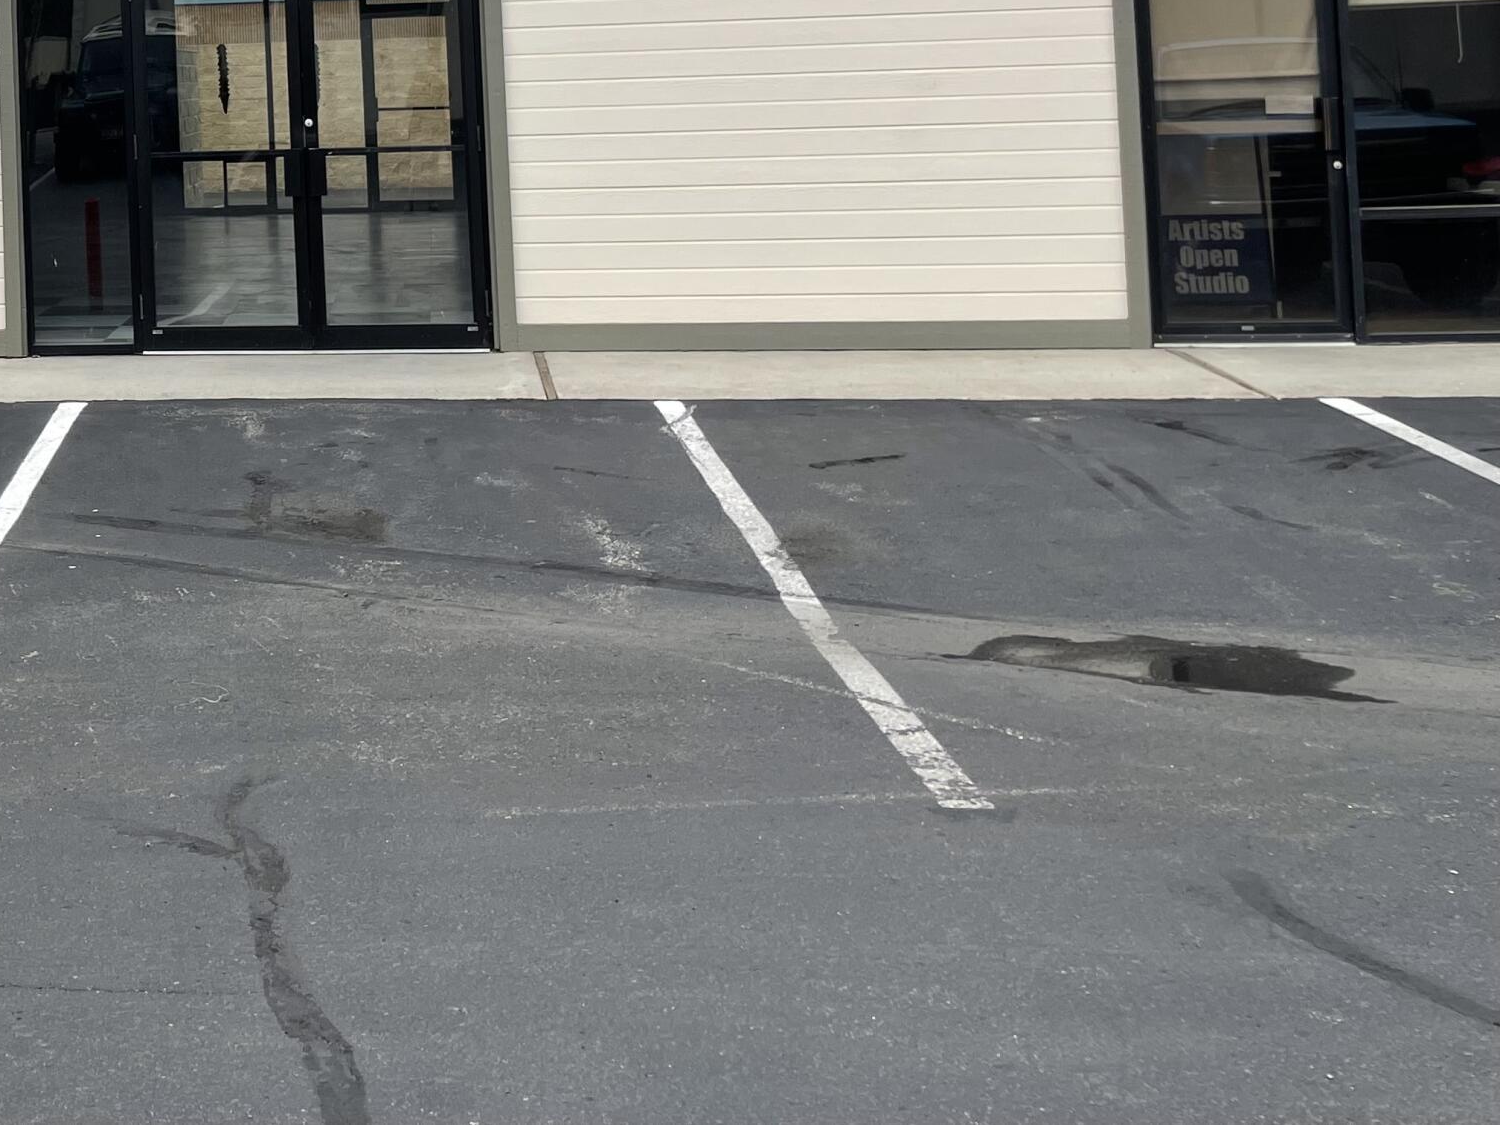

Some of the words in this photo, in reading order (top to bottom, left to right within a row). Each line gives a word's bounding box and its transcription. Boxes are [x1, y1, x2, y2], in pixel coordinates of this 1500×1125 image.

[1168, 219, 1245, 241] Artists
[1180, 245, 1239, 270] Open
[1174, 271, 1250, 294] Studio
